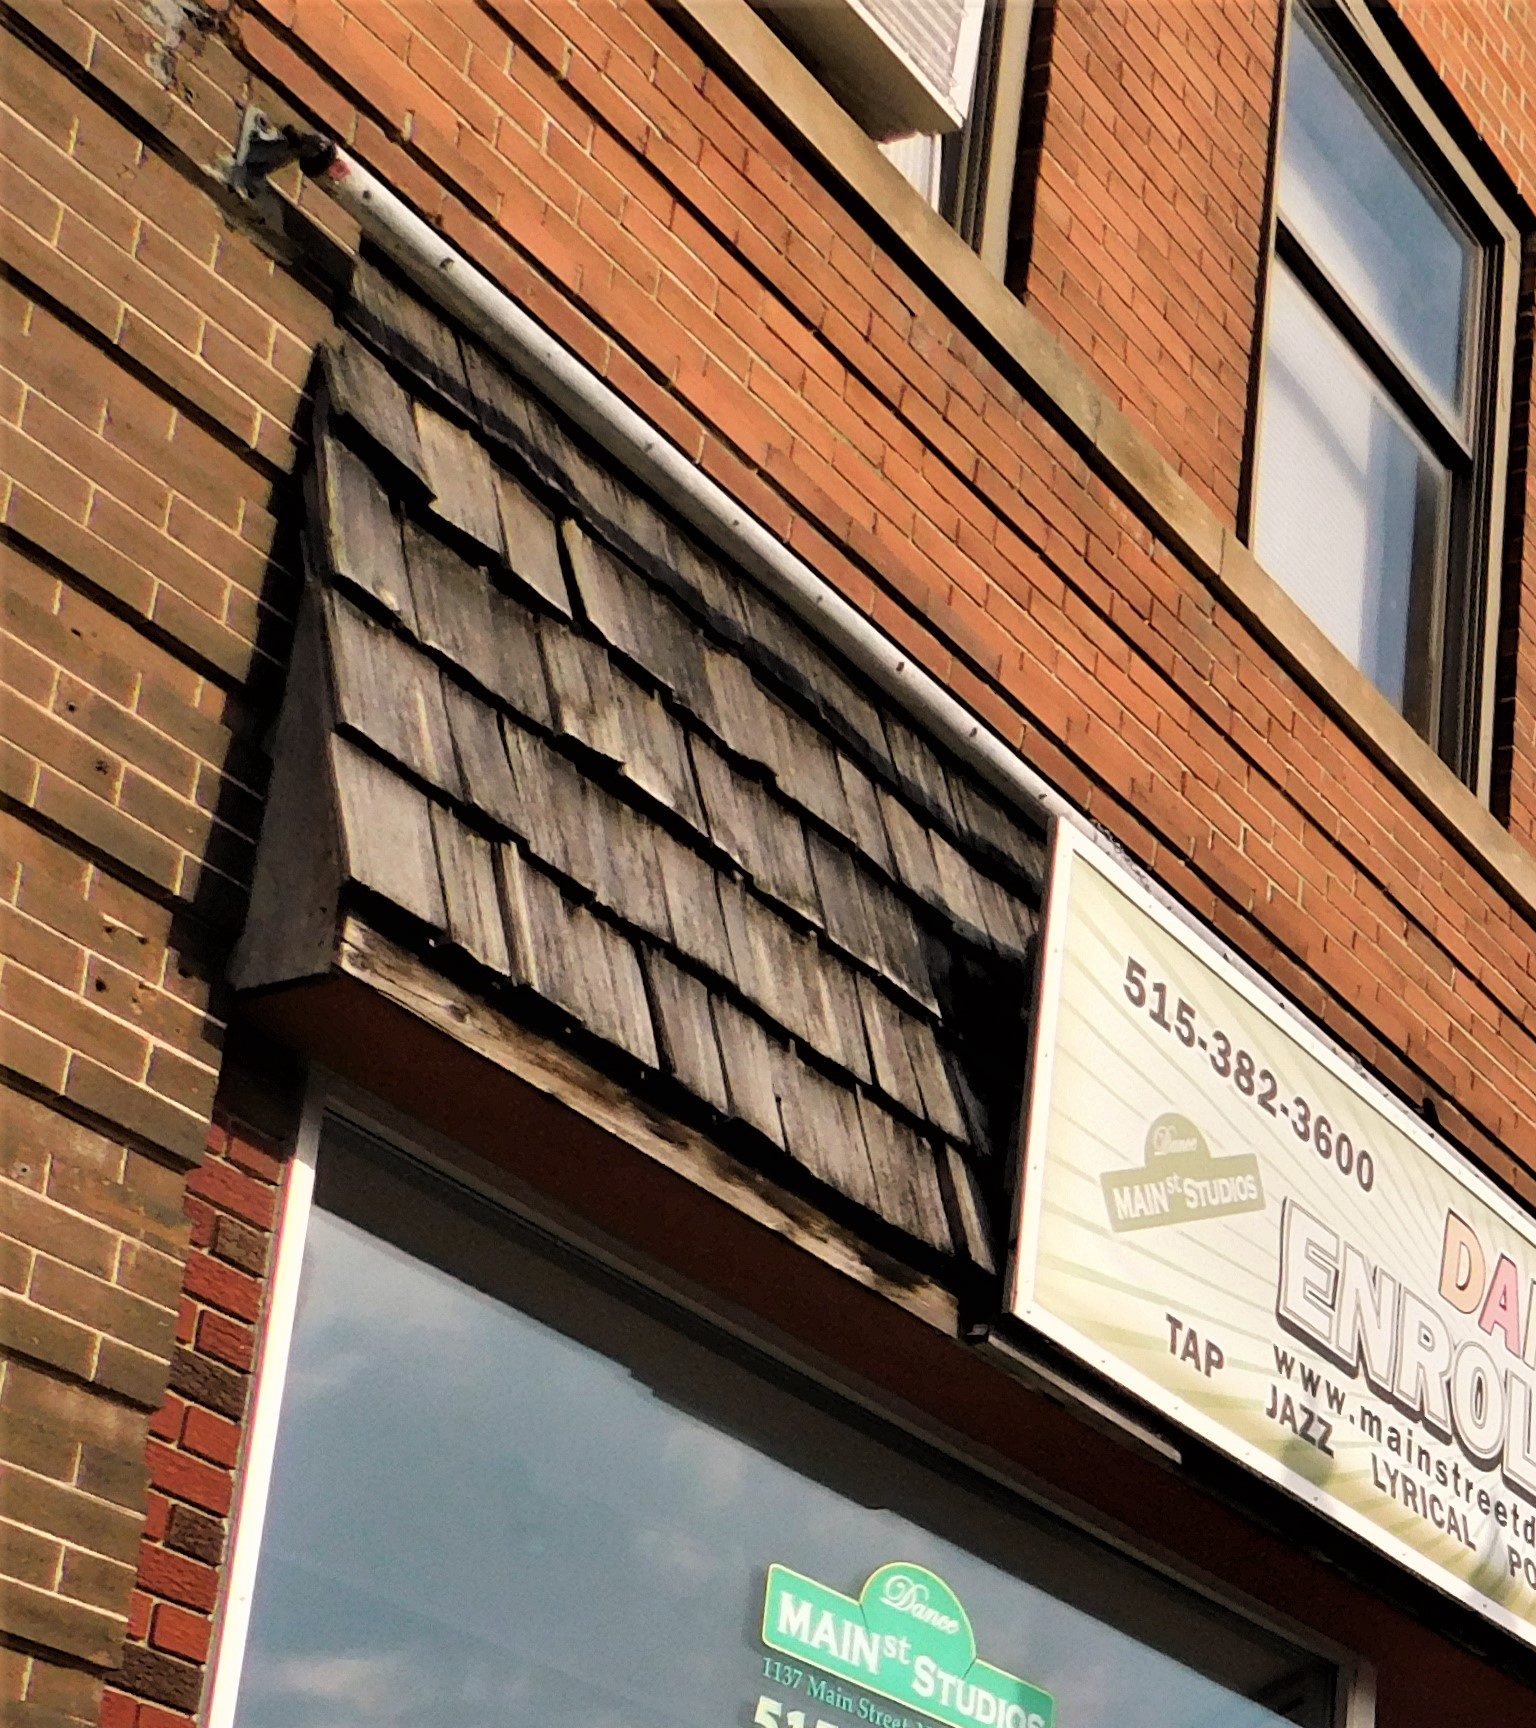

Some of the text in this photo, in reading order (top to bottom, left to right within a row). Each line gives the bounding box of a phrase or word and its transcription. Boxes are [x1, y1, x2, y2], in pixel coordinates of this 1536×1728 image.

[1123, 956, 1374, 1193] 515-382-3600
[1112, 1181, 1170, 1220] MAIN
[1183, 1173, 1258, 1208] STUDIOS
[1166, 1312, 1224, 1378] TAP
[1265, 1384, 1334, 1459] JAZZ
[1371, 1452, 1477, 1551] LYRICAL
[778, 1591, 879, 1676] MAIN
[883, 1634, 911, 1666] st
[880, 1574, 960, 1636] Dance
[762, 1657, 802, 1689] 1137
[806, 1674, 854, 1713] Main
